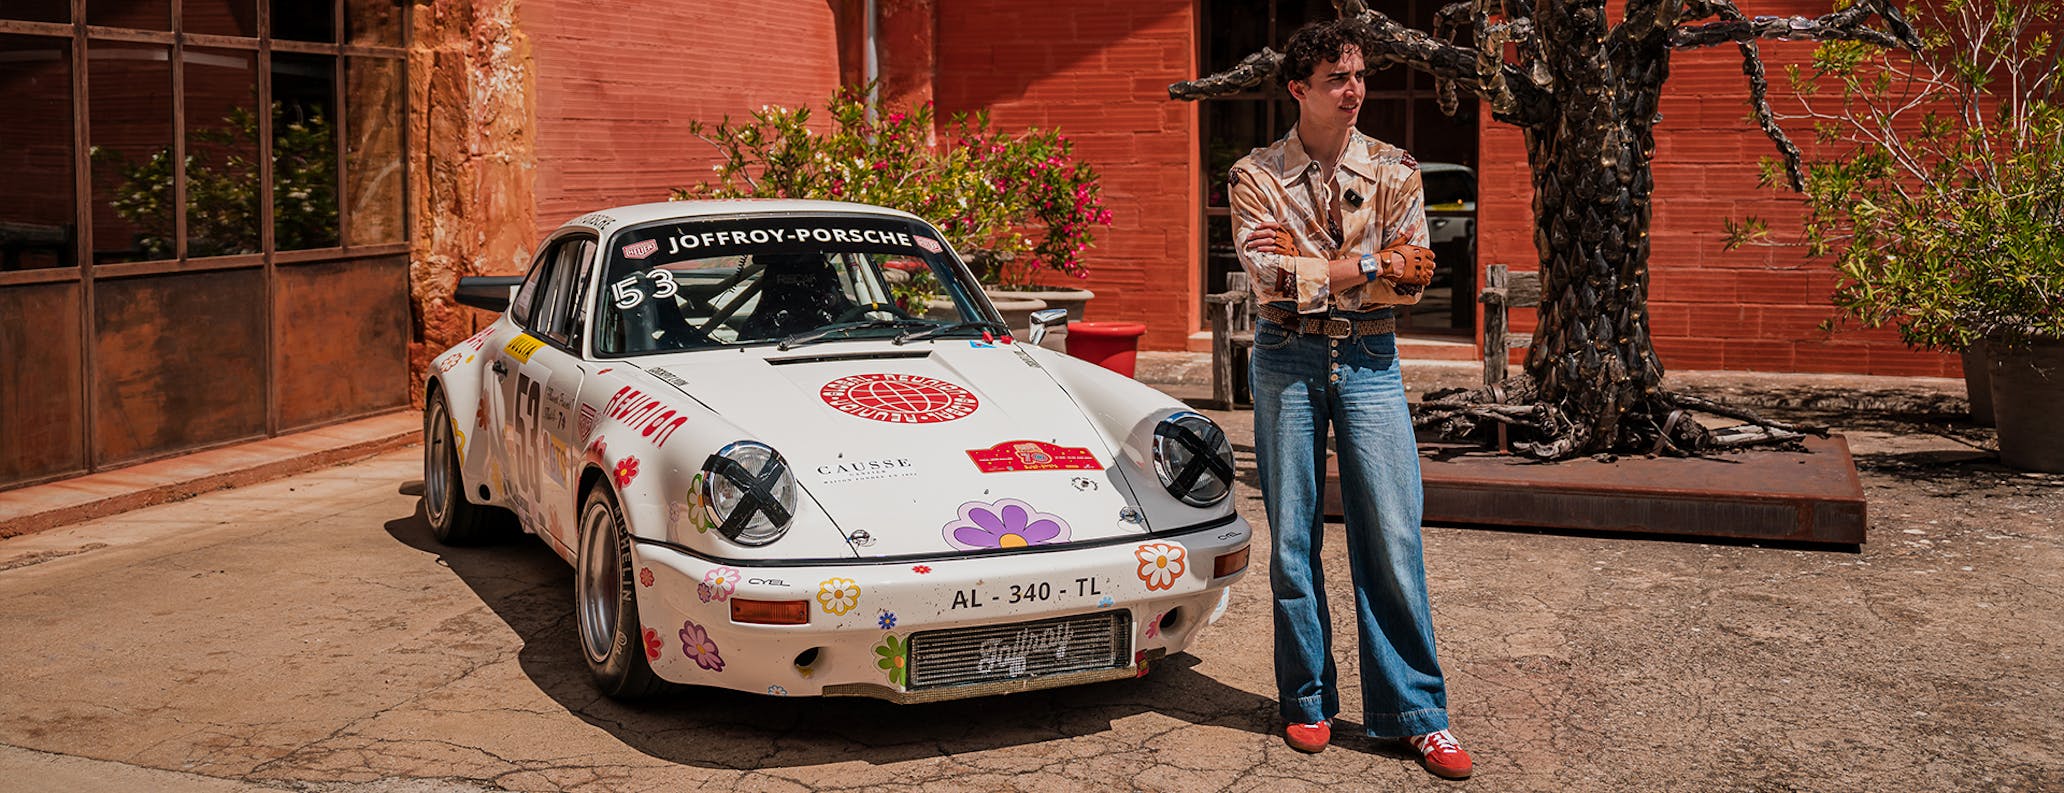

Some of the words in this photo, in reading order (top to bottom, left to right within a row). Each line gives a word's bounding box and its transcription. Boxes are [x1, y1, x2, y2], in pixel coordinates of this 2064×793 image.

[669, 228, 912, 254] JOFFROY-PORSCHE
[611, 269, 678, 310] 53
[515, 372, 541, 503] 53
[603, 386, 688, 449] REUNION
[817, 458, 911, 475] CAUSSE
[613, 502, 632, 602] MICHELIN
[951, 589, 983, 610] AL
[1008, 581, 1051, 604] 340
[1075, 576, 1101, 597] TL
